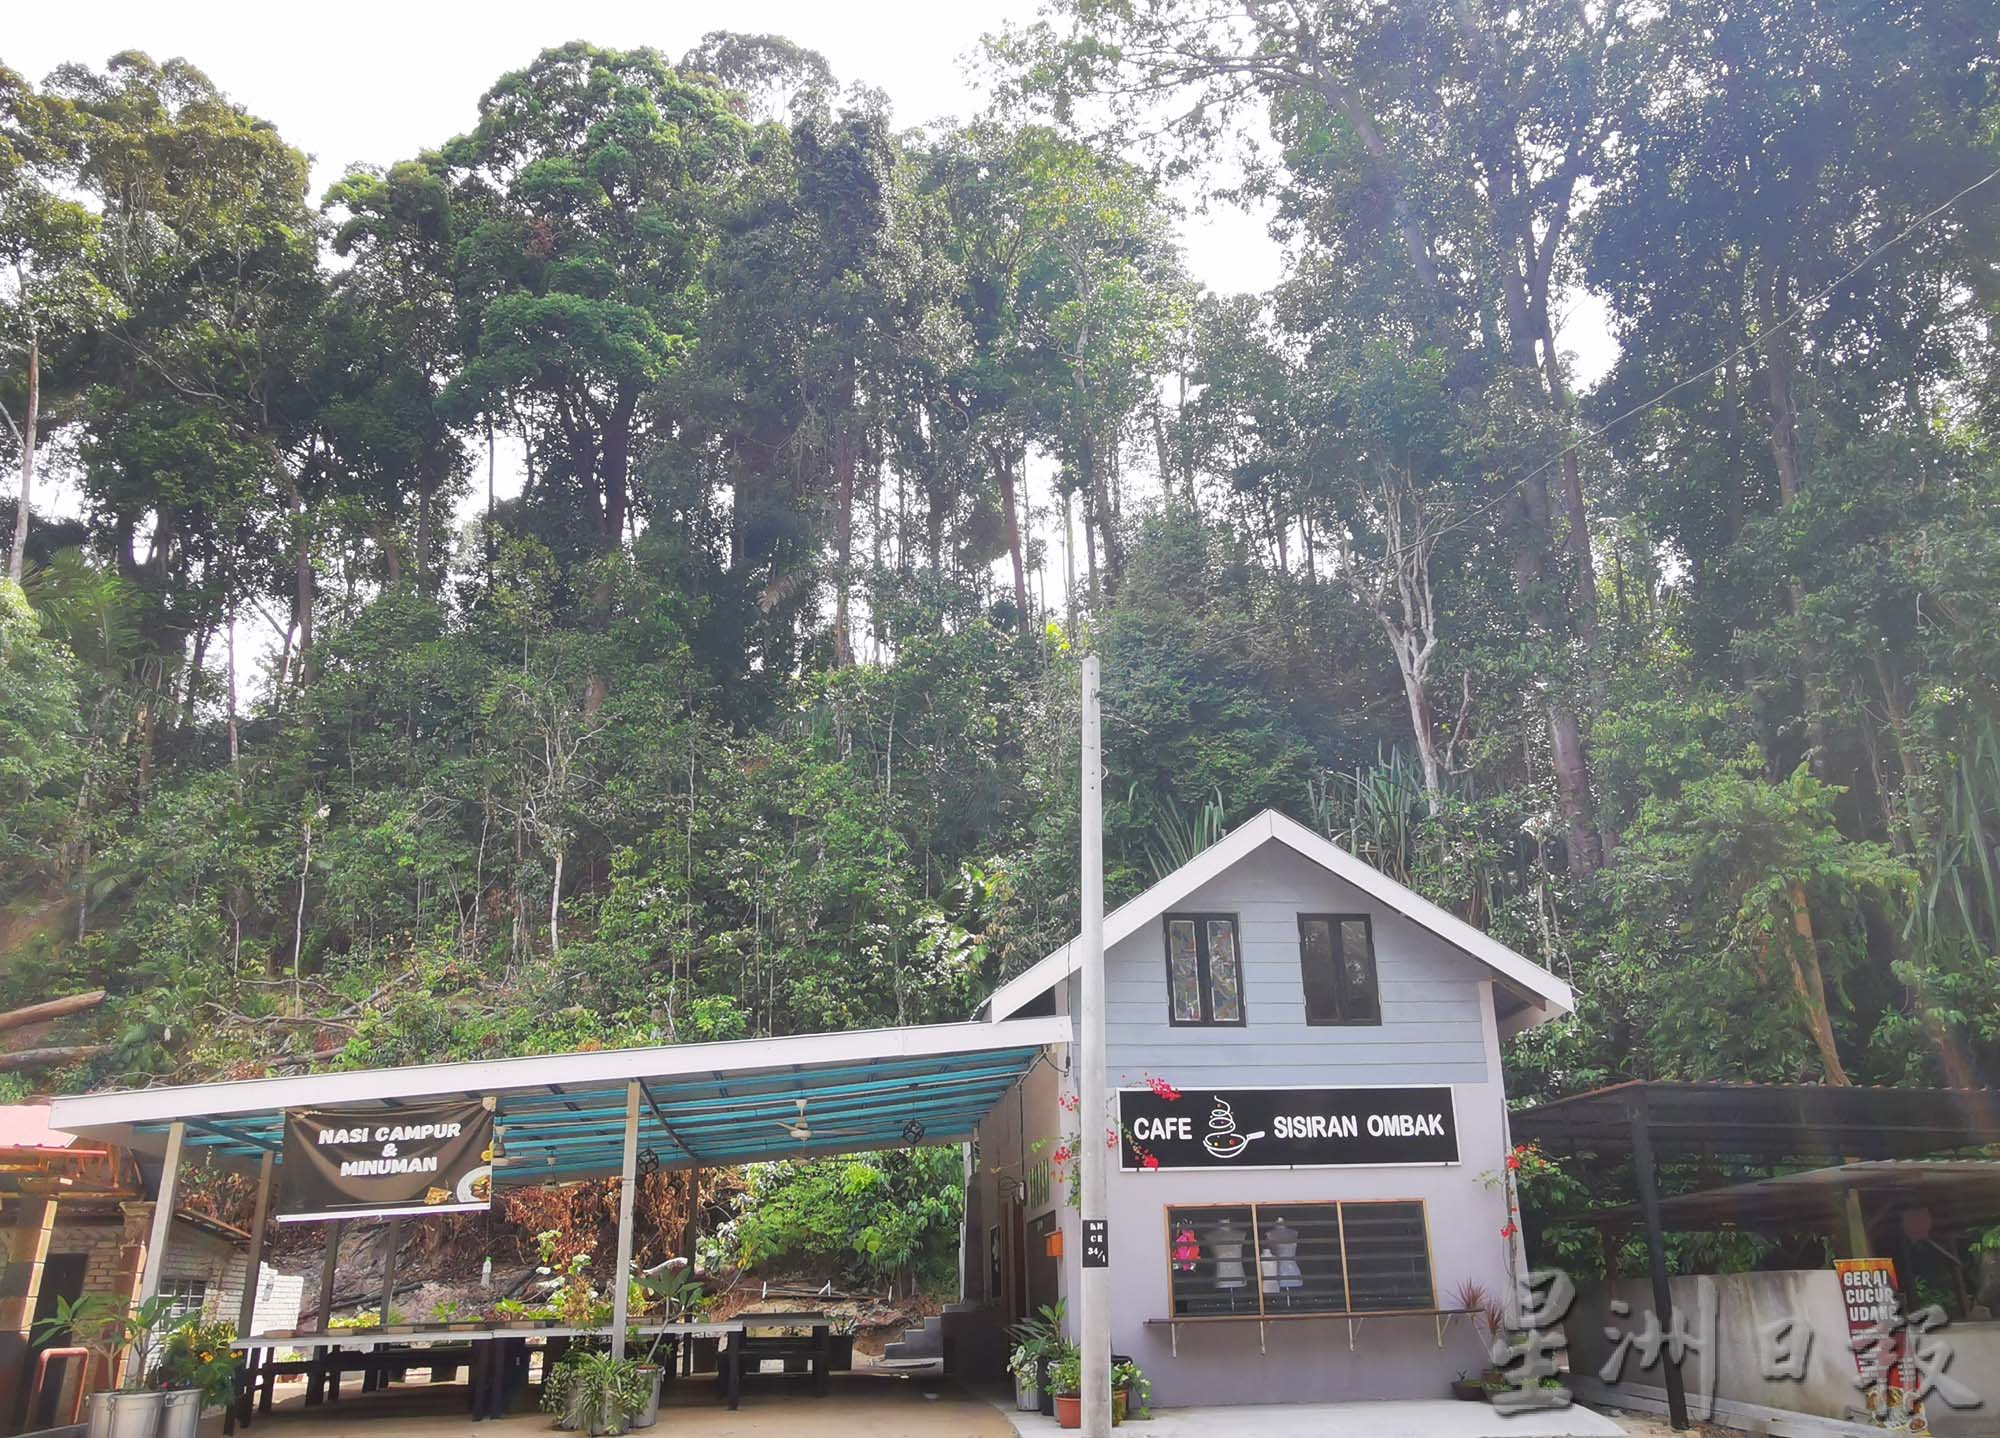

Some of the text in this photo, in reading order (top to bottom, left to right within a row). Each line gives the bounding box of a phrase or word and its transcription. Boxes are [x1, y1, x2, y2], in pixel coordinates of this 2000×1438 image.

[318, 1122, 462, 1145] NASI CAMPUR
[1133, 1113, 1445, 1140] CAFE SISIRAN OMBAK
[381, 1143, 398, 1158] &
[340, 1156, 438, 1177] MINUMAN
[1845, 1287, 1896, 1304] CUCUR
